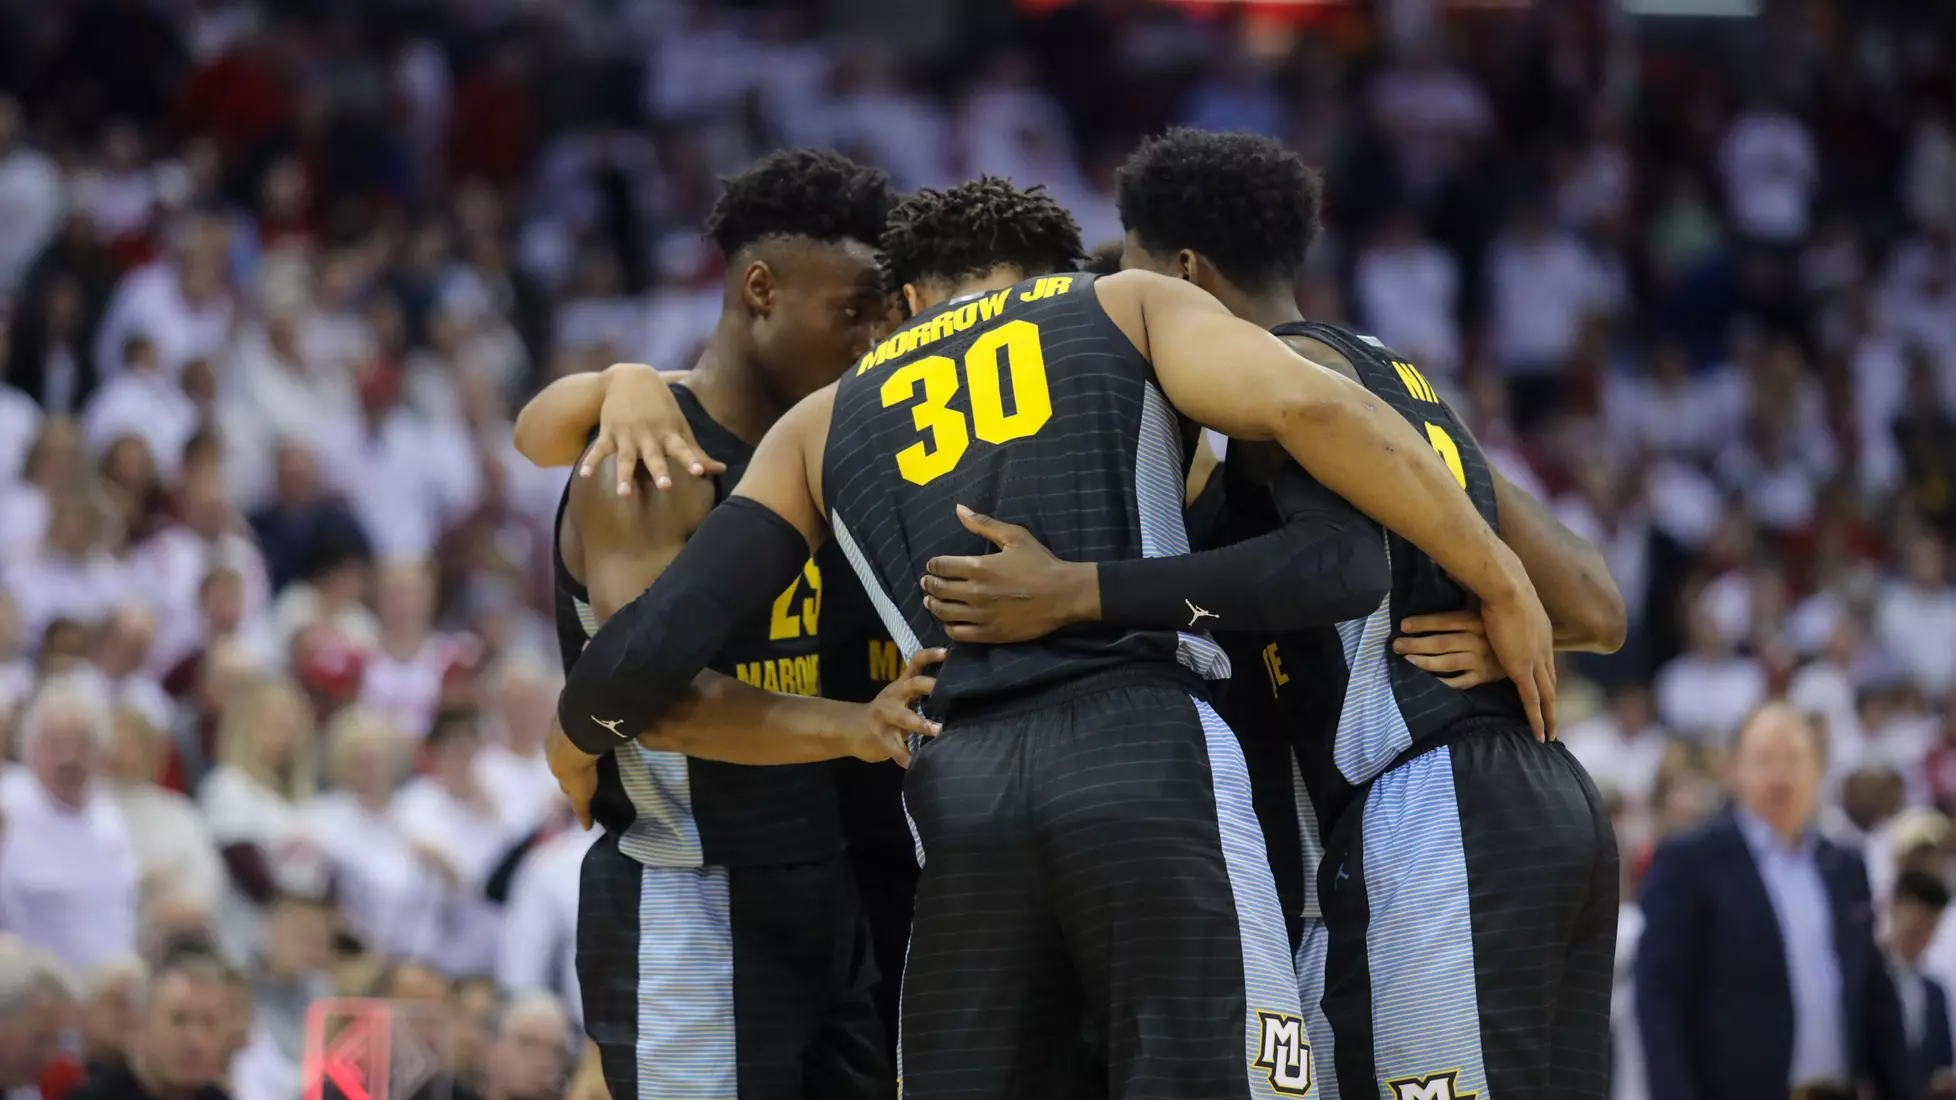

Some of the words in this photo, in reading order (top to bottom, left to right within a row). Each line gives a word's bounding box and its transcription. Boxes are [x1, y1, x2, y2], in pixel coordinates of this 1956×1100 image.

[856, 287, 1012, 376] MORROW
[1020, 276, 1073, 302] JR
[880, 319, 1053, 486] 30
[869, 640, 907, 681] M
[1256, 1012, 1311, 1094] MU
